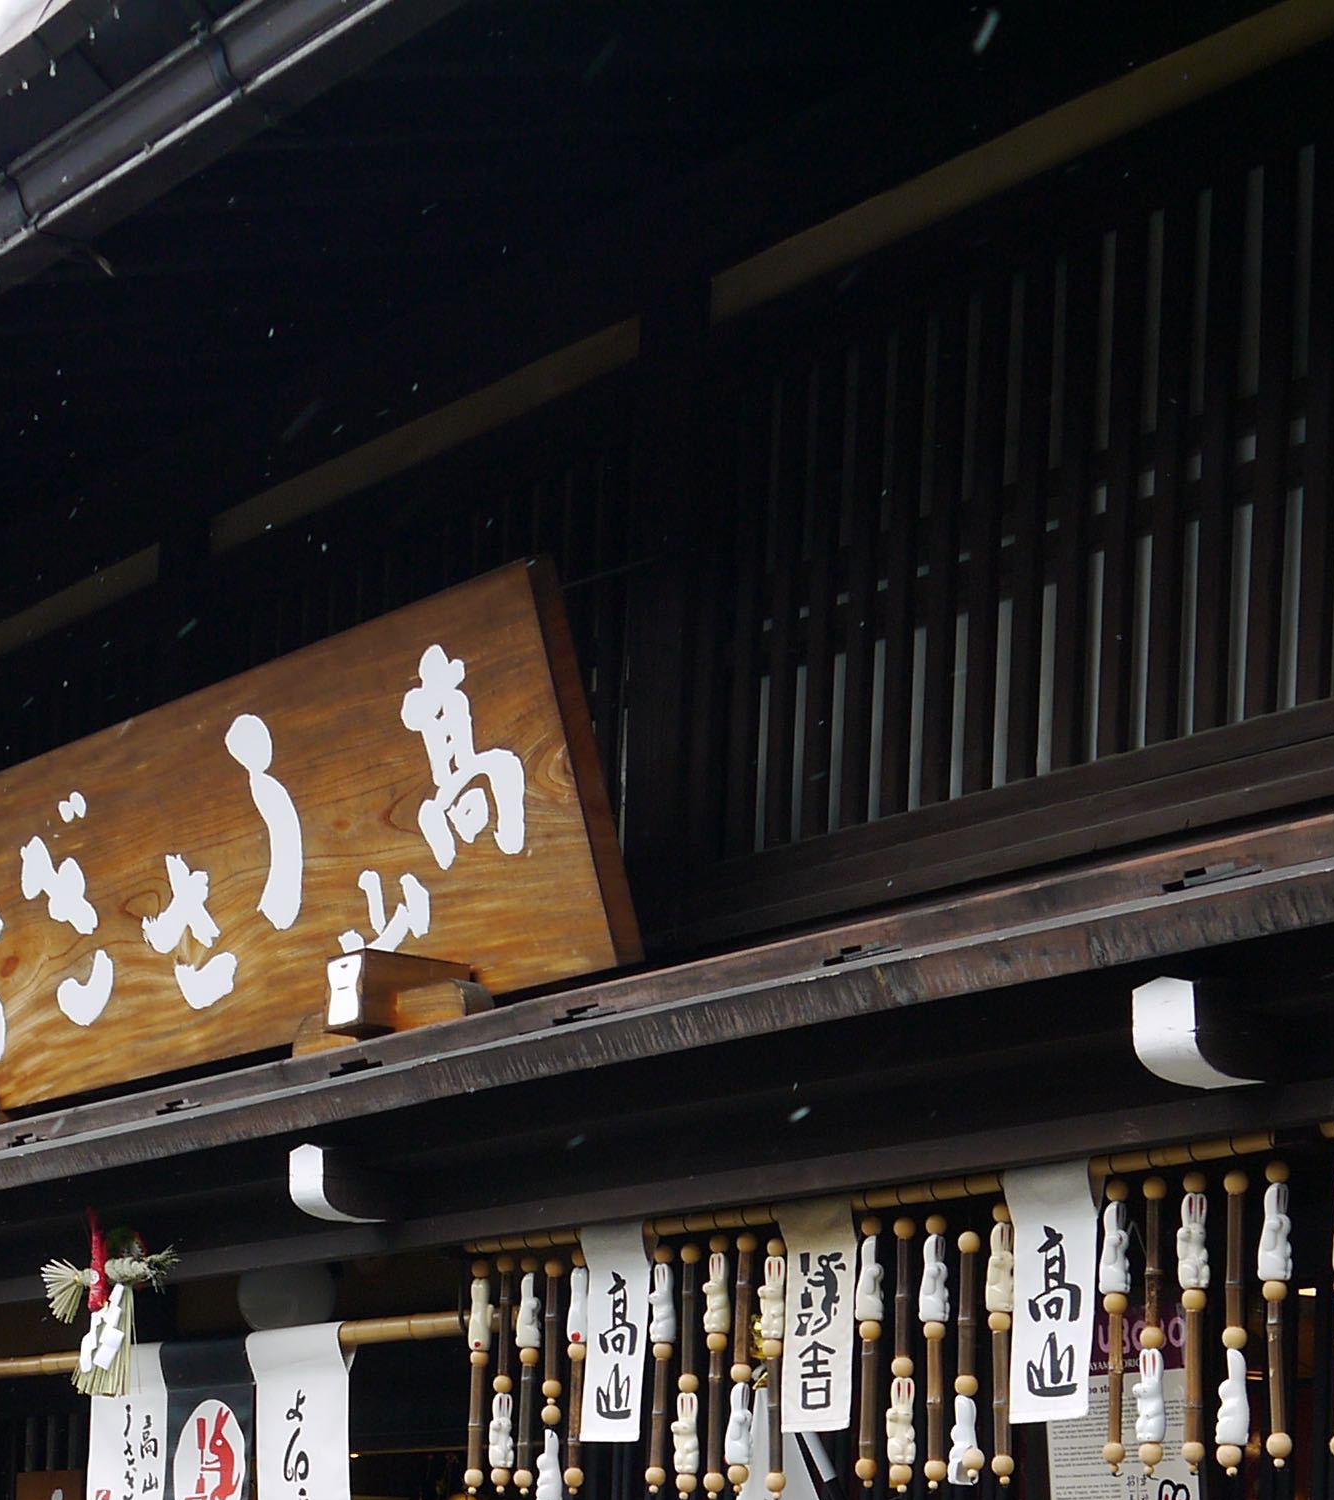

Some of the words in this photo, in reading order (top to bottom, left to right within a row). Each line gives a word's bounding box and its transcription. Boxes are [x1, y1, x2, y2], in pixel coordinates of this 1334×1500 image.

[597, 1270, 637, 1420] 高山
[1027, 1225, 1082, 1399] 高山
[139, 1414, 159, 1495] 高山
